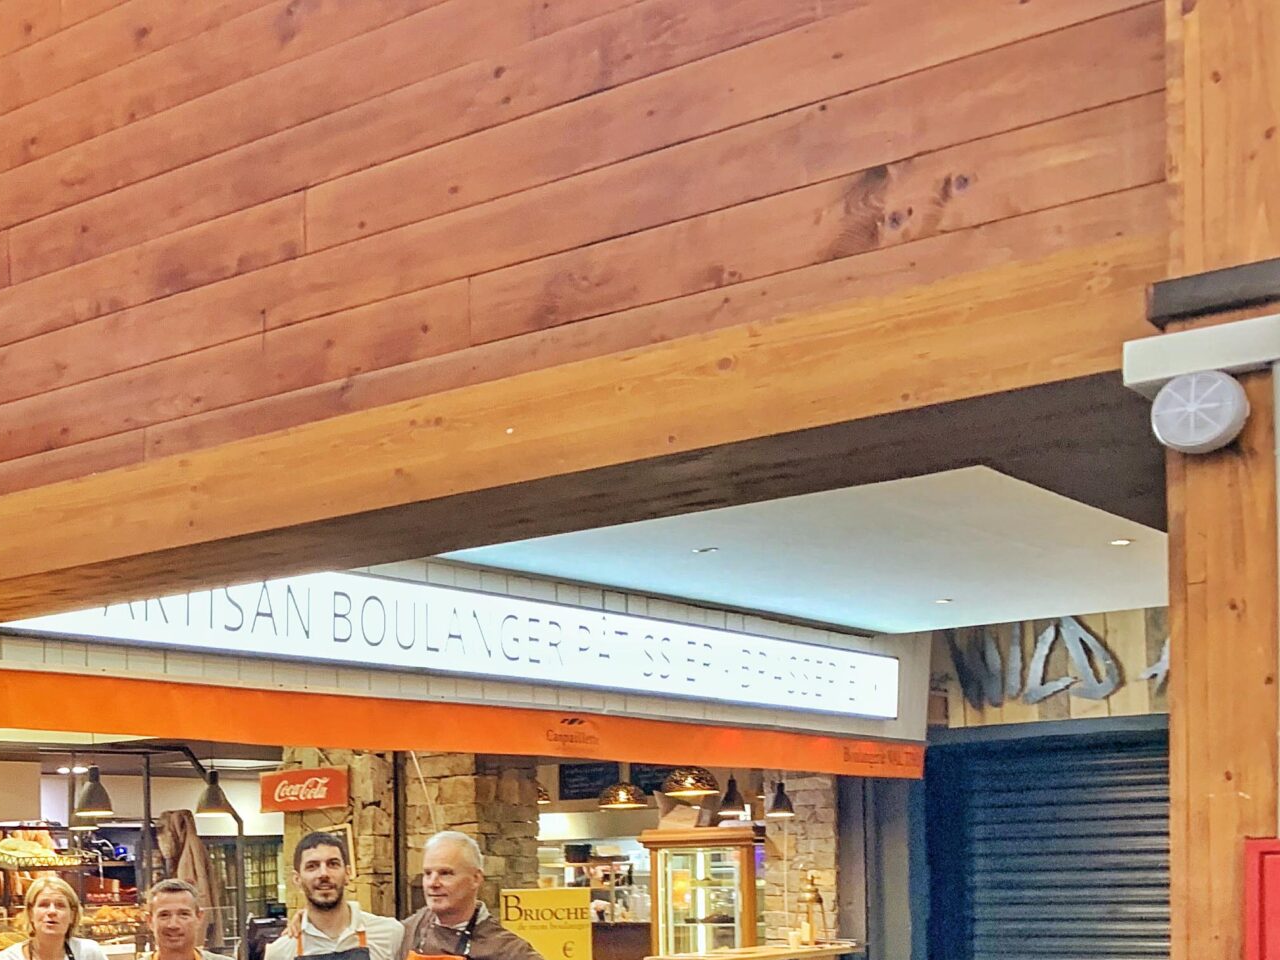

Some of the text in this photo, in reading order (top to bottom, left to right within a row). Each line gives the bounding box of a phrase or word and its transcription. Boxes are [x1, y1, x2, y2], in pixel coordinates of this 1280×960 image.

[332, 591, 564, 667] BOULANGER
[502, 894, 589, 922] BRIOCHE
[562, 940, 575, 959] €
